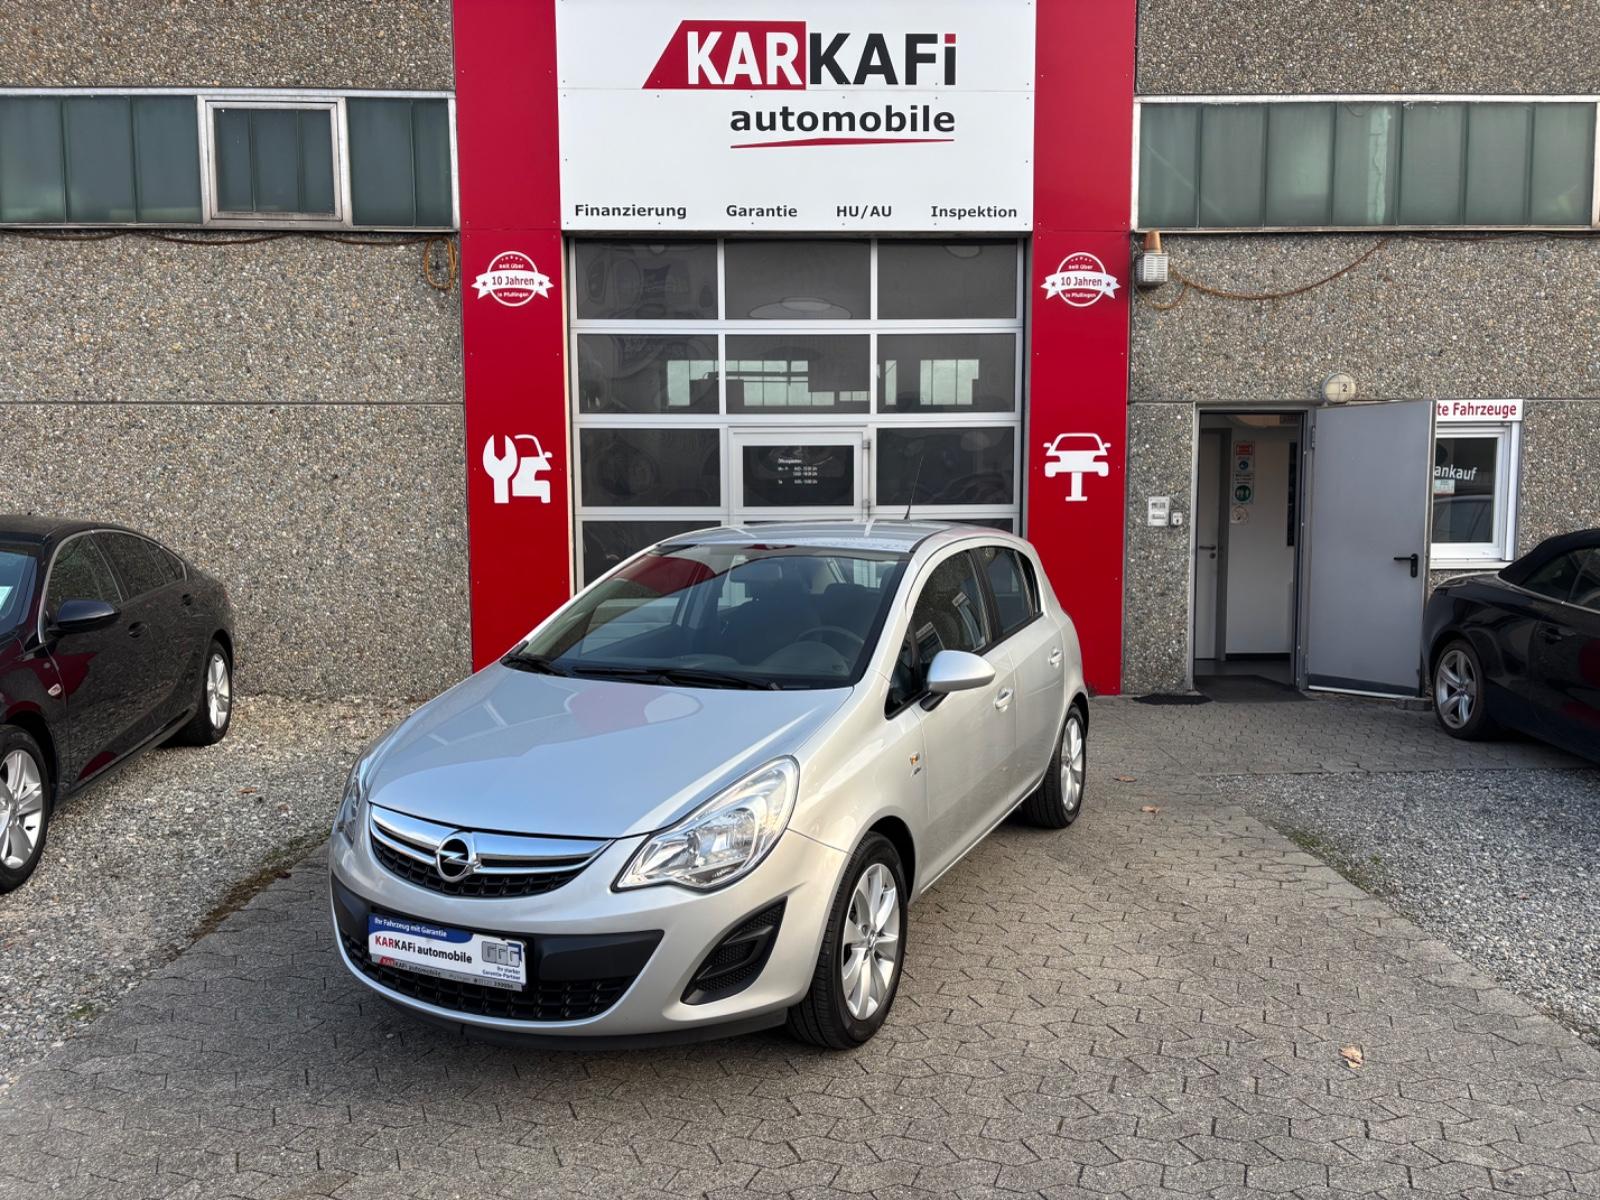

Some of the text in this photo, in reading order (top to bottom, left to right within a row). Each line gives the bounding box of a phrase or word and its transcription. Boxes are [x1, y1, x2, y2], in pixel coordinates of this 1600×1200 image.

[730, 105, 956, 132] automobile
[575, 204, 687, 220] Finanzierung
[726, 204, 798, 218] Garantie
[836, 205, 893, 219] HU/AU
[931, 205, 1017, 221] Inspektion
[492, 276, 535, 286] 10 Jahren
[1061, 276, 1102, 286] 10 Jahren
[1342, 383, 1348, 393] 2
[1453, 402, 1517, 419] Fahrzeuge
[374, 917, 447, 938] Ihr Fahrzeug mit Garantie
[375, 935, 473, 964] KARKAFi automobile
